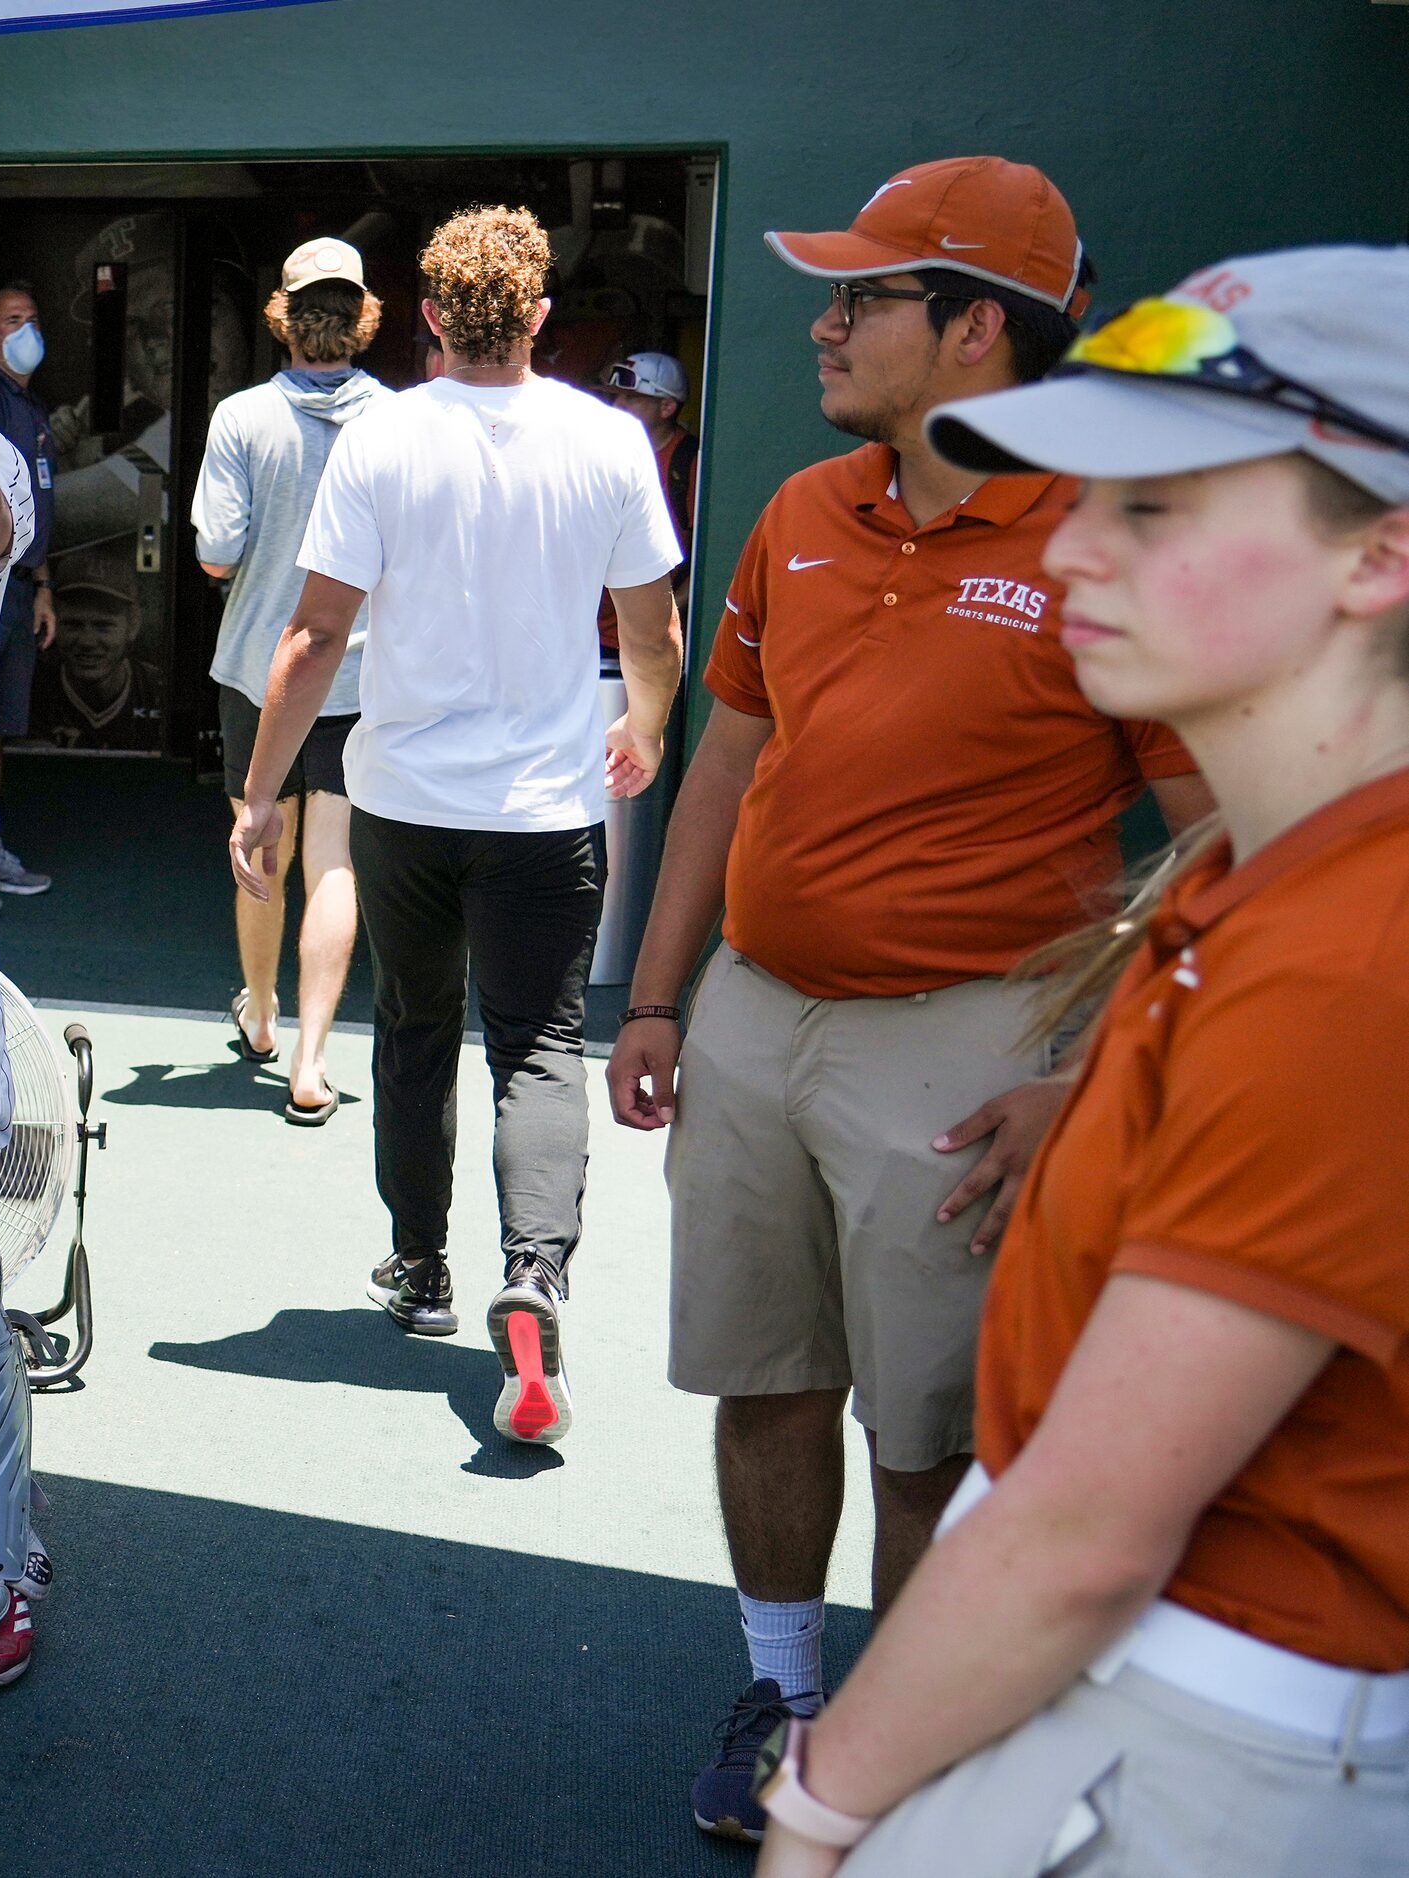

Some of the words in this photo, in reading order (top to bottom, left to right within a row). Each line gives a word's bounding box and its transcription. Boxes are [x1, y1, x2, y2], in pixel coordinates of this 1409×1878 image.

[957, 578, 1047, 619] TEXAS
[945, 605, 984, 620] SPORTS
[985, 613, 1049, 633] MEDICINE
[634, 1006, 655, 1017] WAVE
